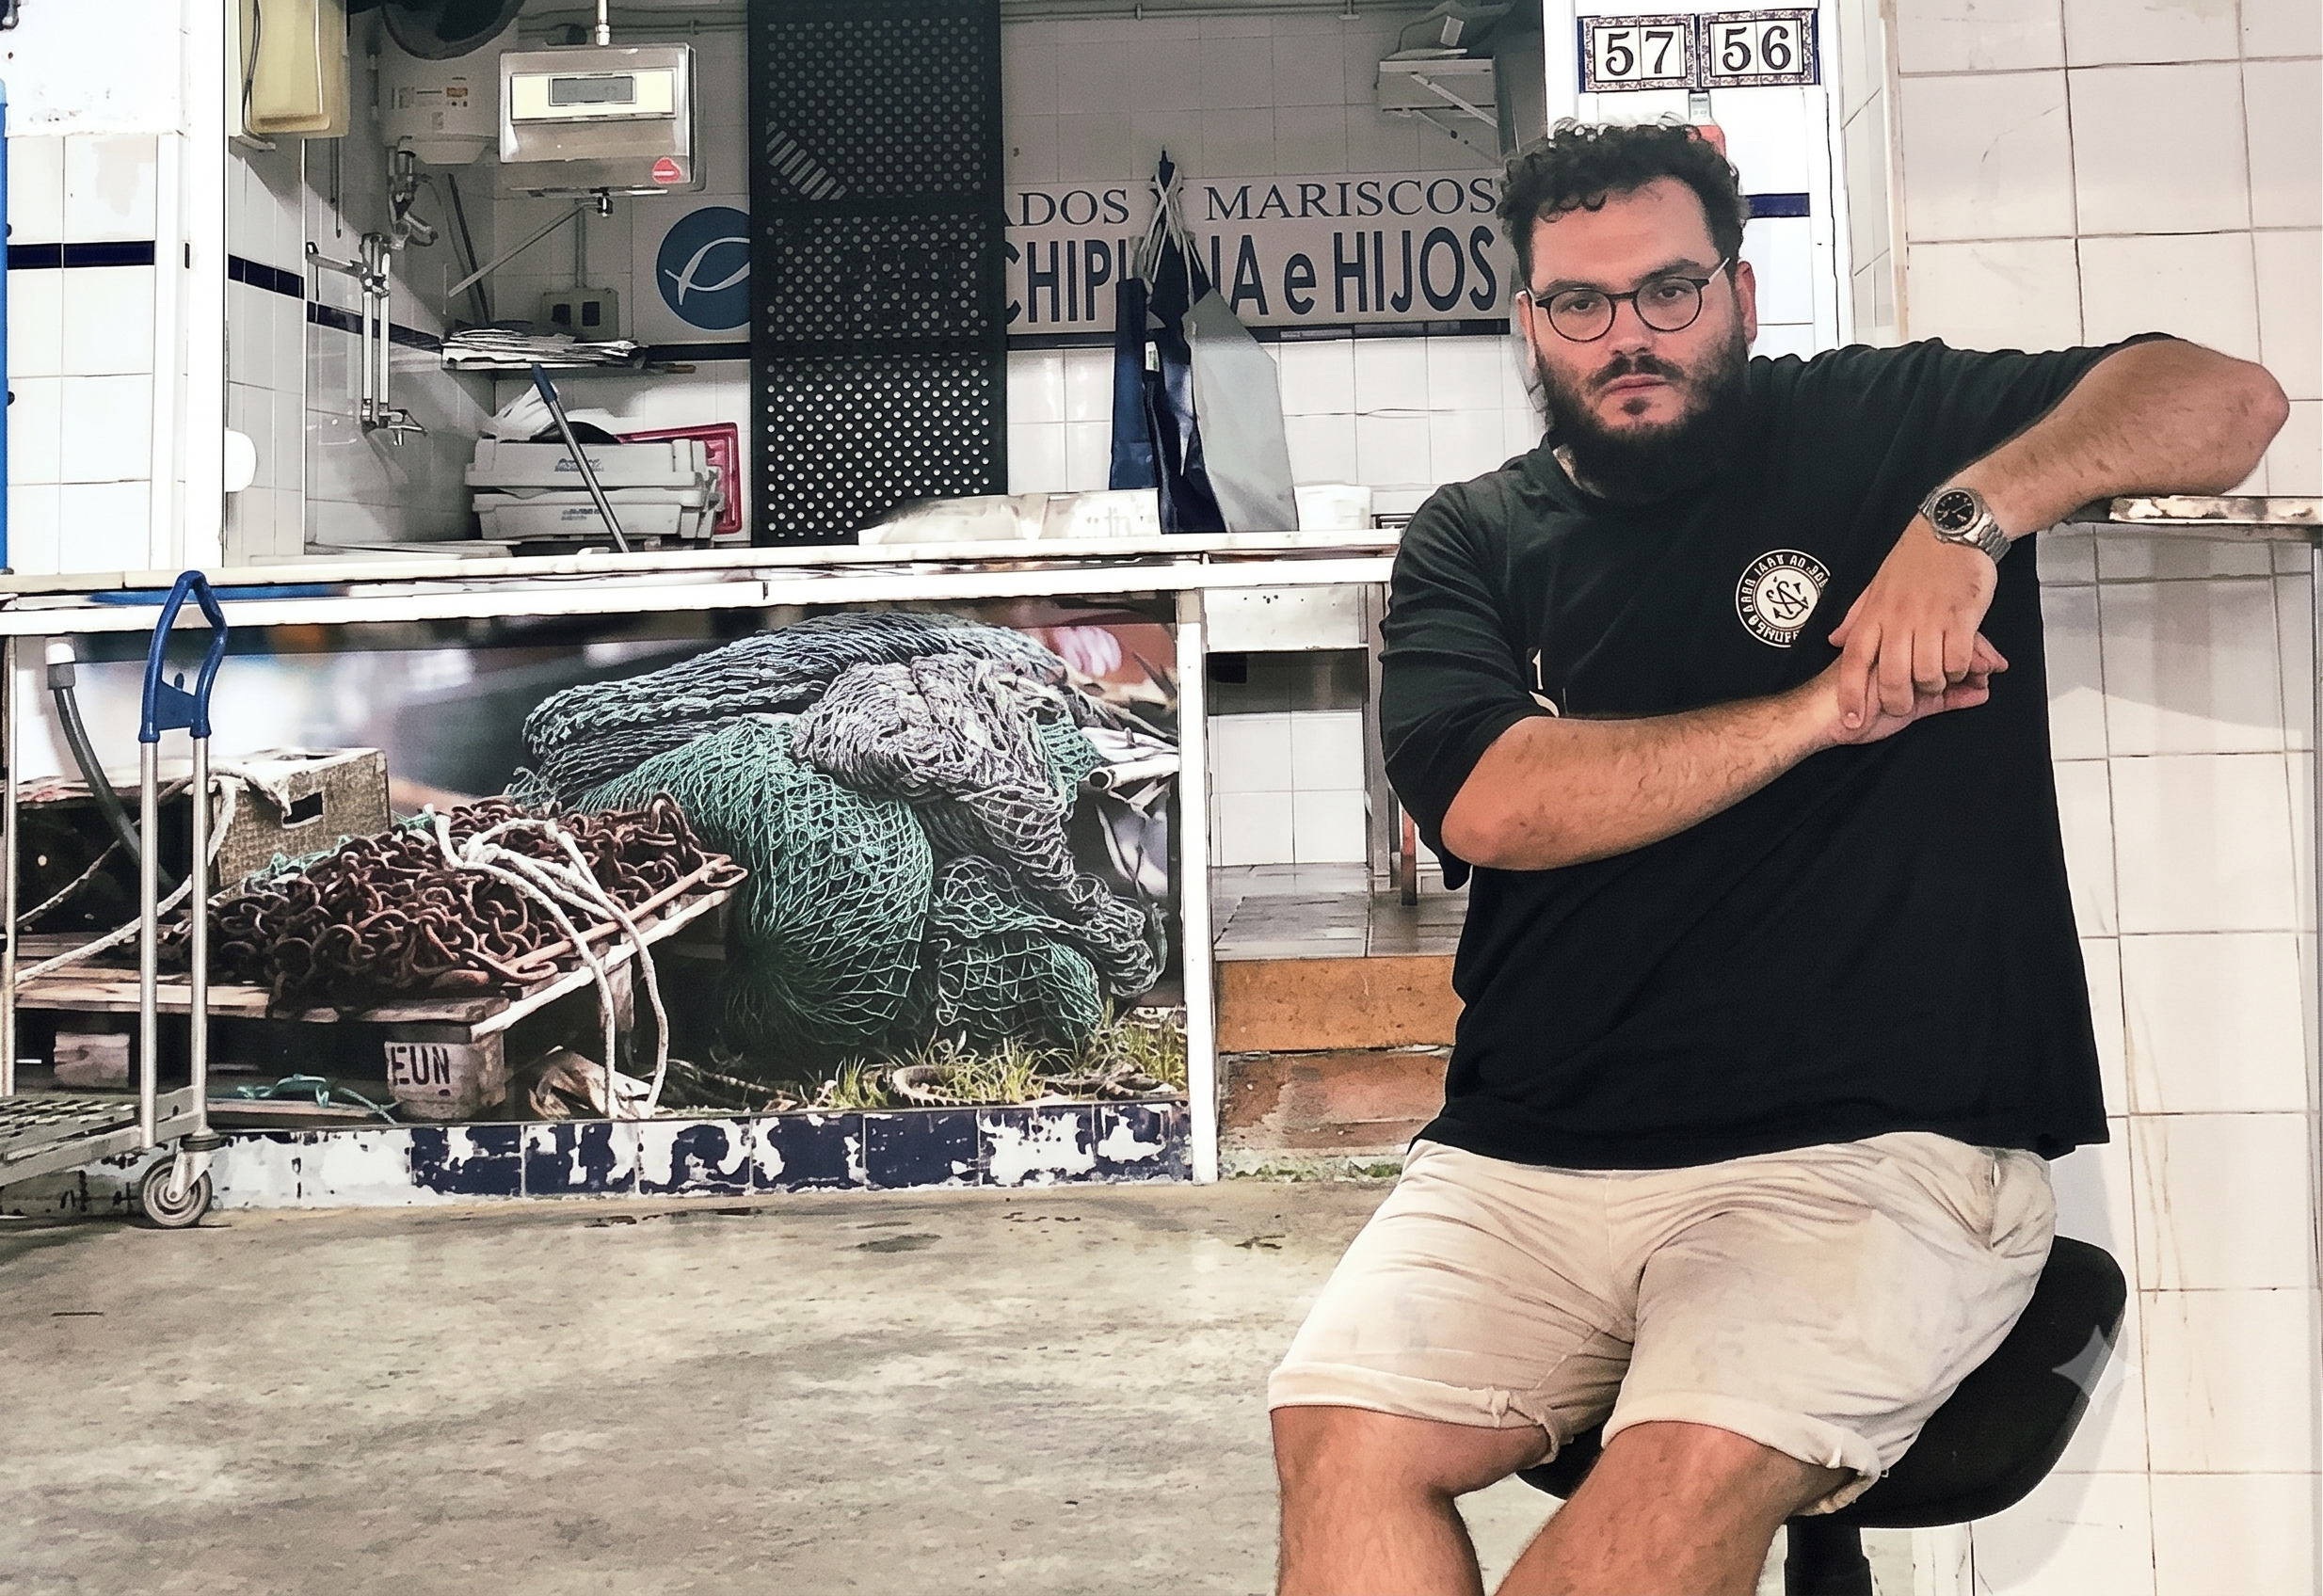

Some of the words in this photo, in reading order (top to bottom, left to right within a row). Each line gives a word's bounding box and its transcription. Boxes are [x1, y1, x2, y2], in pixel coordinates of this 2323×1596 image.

[1605, 30, 1674, 76] 57
[1722, 25, 1792, 72] 56
[1003, 188, 1129, 227] DOS
[1204, 178, 1497, 222] MARISCOS
[1284, 253, 1317, 316] e
[1333, 226, 1497, 314] HIJOS
